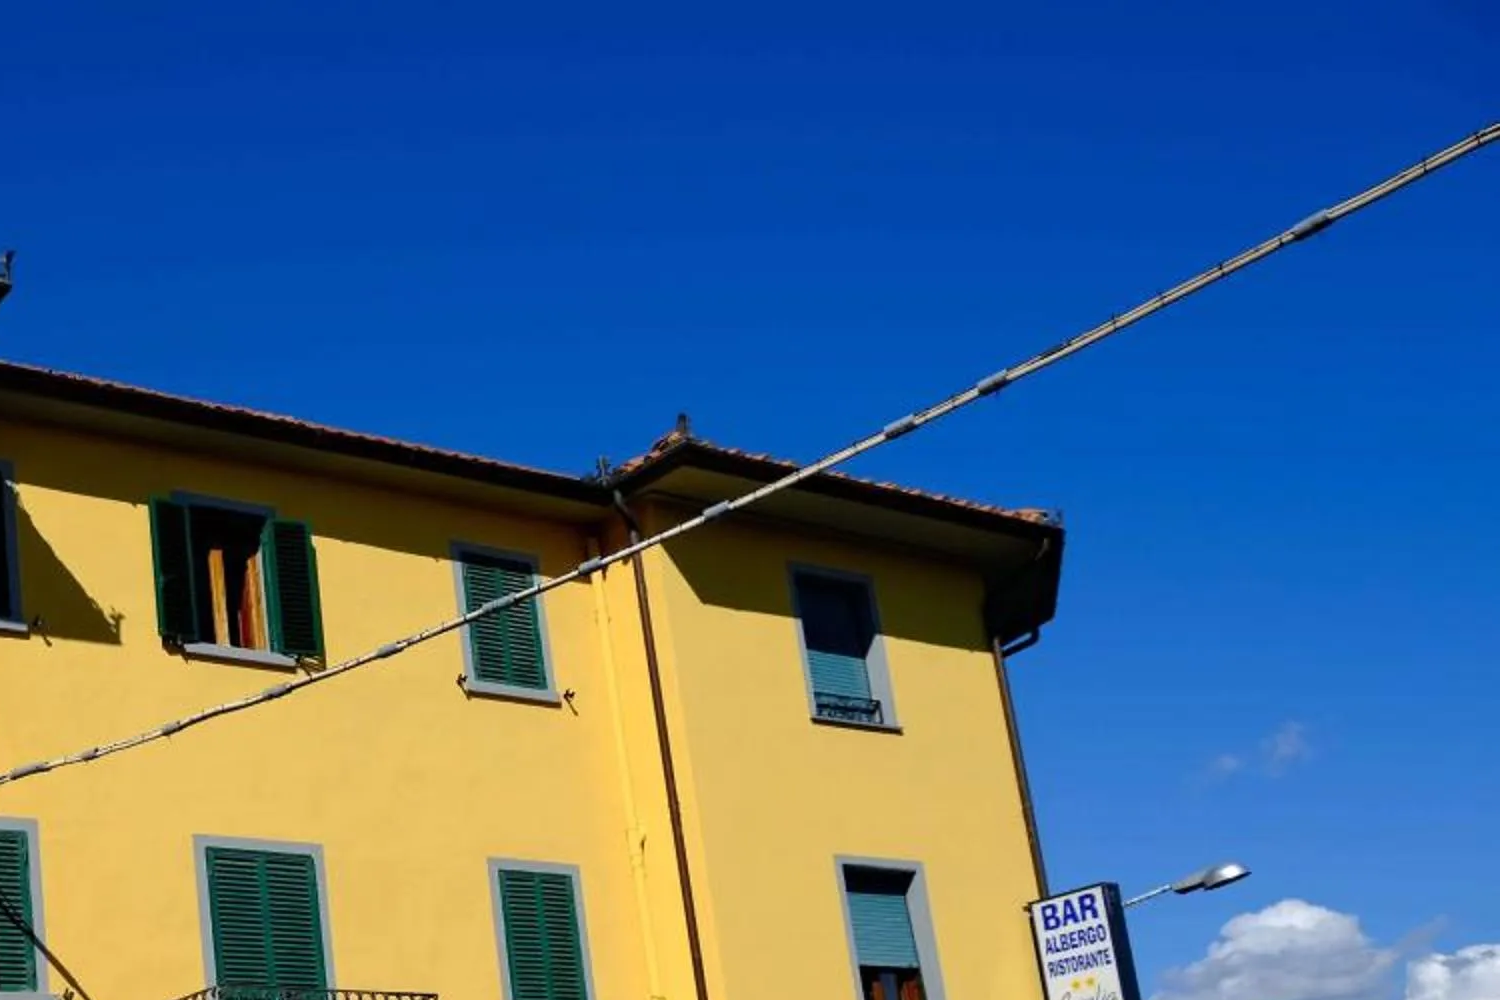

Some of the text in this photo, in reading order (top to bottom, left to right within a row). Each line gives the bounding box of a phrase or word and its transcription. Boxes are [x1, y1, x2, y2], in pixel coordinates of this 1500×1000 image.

[1041, 893, 1099, 931] BAR
[1045, 924, 1107, 955] ALBERGO
[1048, 949, 1112, 978] RISTORANTE
